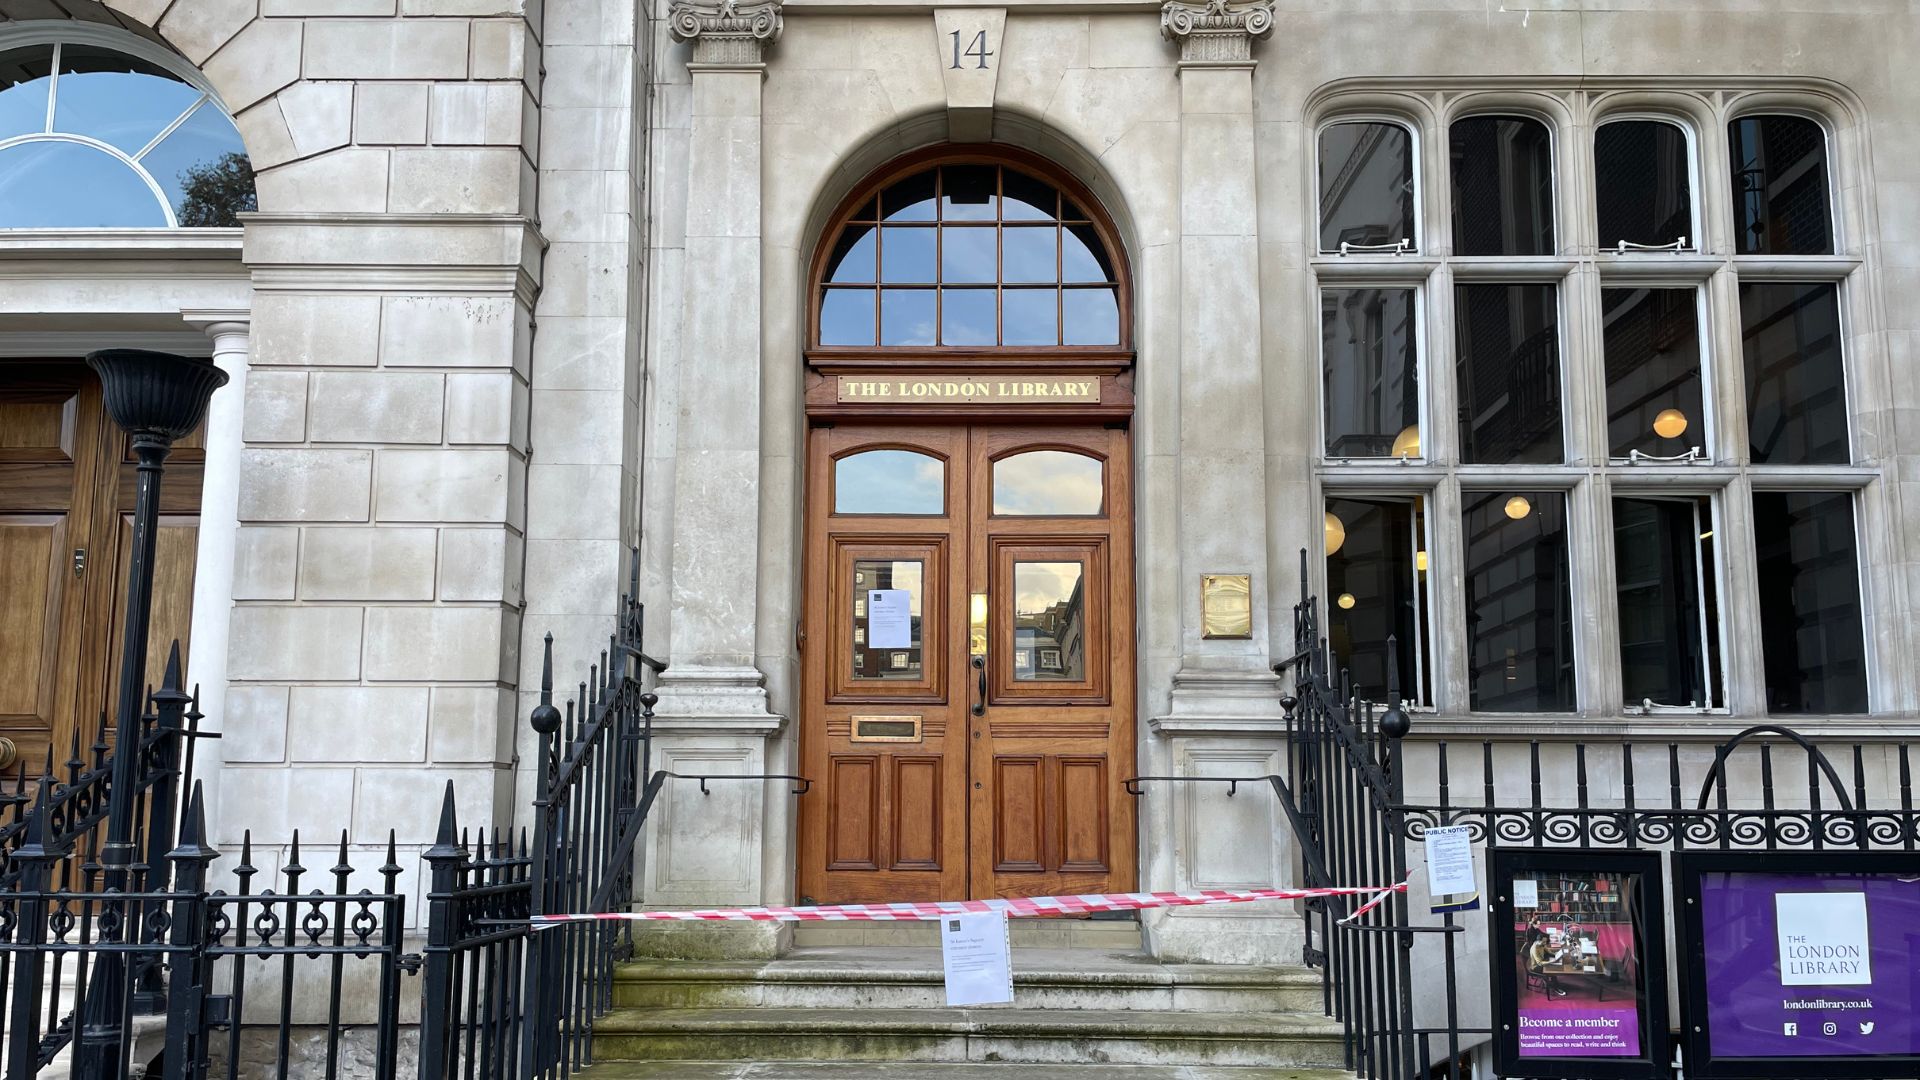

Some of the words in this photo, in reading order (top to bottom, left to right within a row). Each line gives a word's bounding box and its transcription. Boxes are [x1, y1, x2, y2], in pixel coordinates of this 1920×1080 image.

[948, 29, 994, 69] 14
[846, 382, 891, 396] THE
[899, 382, 990, 396] LONDON
[998, 382, 1092, 396] LIBRARY
[1426, 828, 1447, 836] PUBLIC
[1448, 826, 1468, 834] NOTICE
[1786, 935, 1806, 943] THE
[1789, 945, 1860, 958] LONDON
[1790, 961, 1860, 974] LIBRARY
[1783, 998, 1873, 1011] londonlibrary.co.uk
[1519, 1016, 1564, 1027] Become
[1574, 1016, 1620, 1027] member
[1604, 1033, 1619, 1041] enjoy
